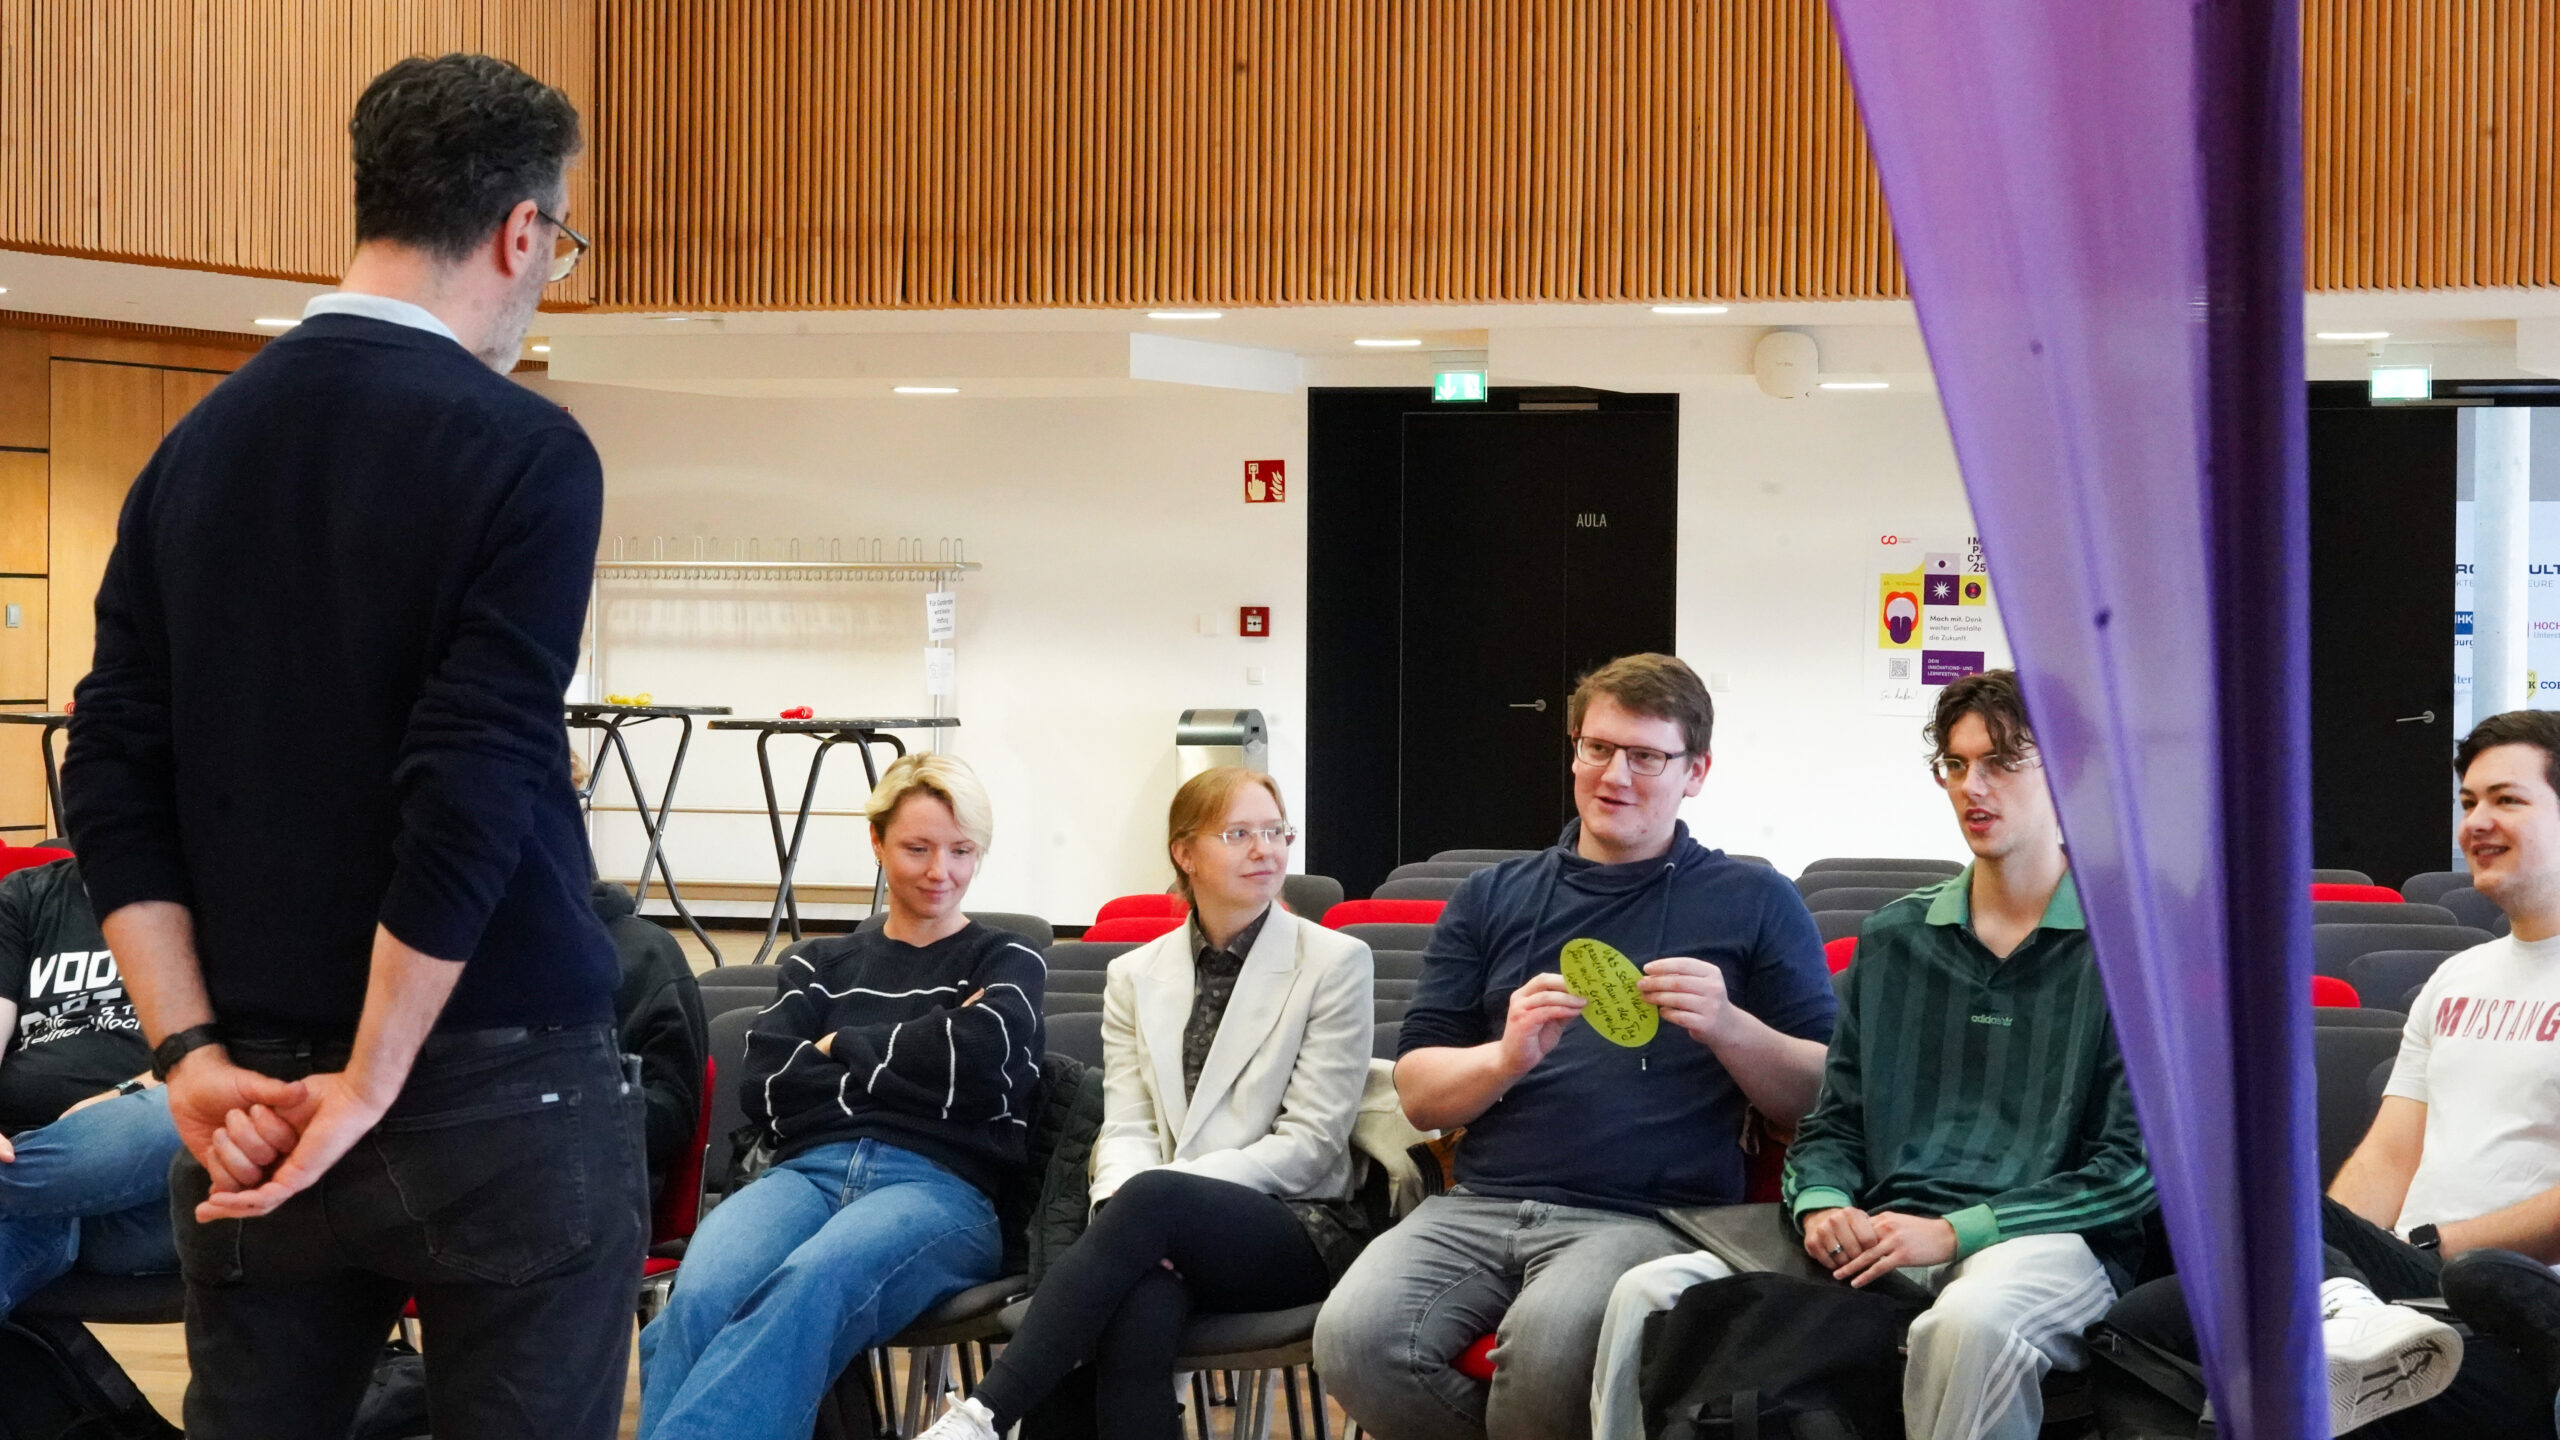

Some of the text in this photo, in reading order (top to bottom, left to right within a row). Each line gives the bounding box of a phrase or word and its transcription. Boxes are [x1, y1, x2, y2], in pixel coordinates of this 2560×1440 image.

[1576, 513, 1607, 528] AULA
[1929, 615, 1949, 623] Mach
[30, 949, 123, 998] VOD
[2434, 996, 2560, 1042] MUSTANG
